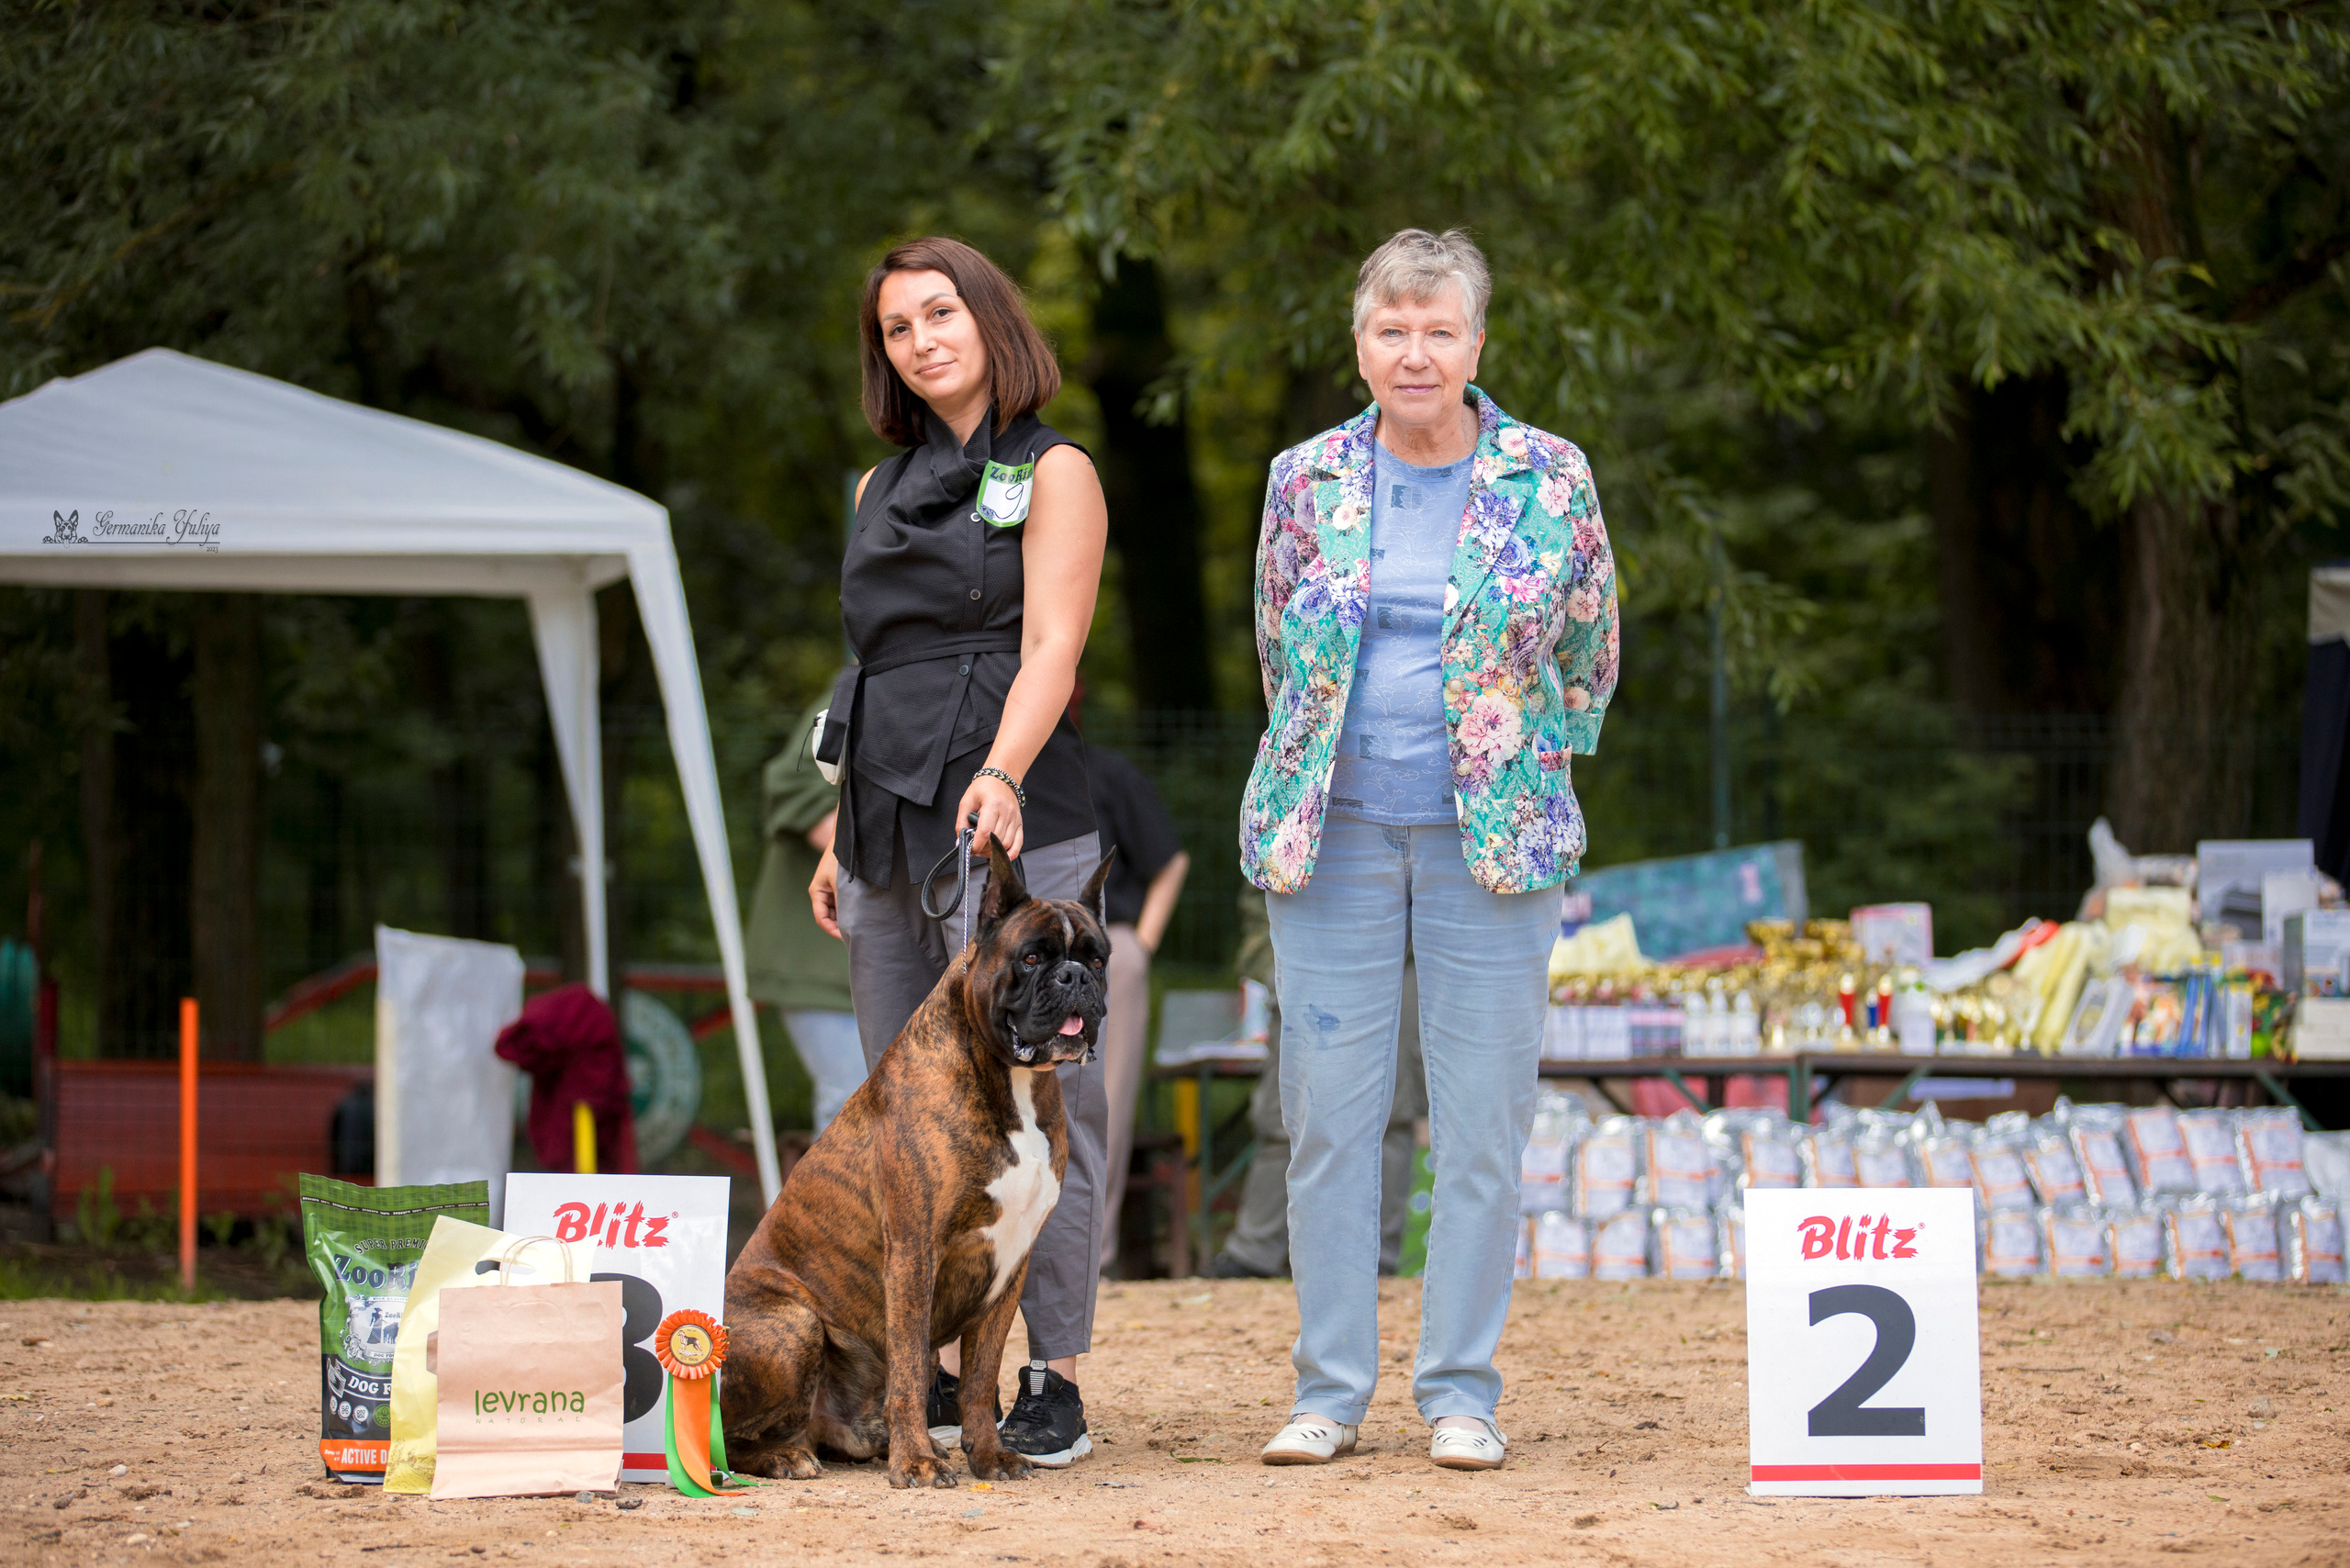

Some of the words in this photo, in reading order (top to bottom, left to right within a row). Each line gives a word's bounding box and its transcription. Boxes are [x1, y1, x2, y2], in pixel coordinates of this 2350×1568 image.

[354, 1238, 387, 1255] SUPER
[1807, 1283, 1926, 1437] 2
[347, 1375, 379, 1394] DOG
[475, 1389, 586, 1417] levrana
[341, 1448, 376, 1464] ACTIVE
